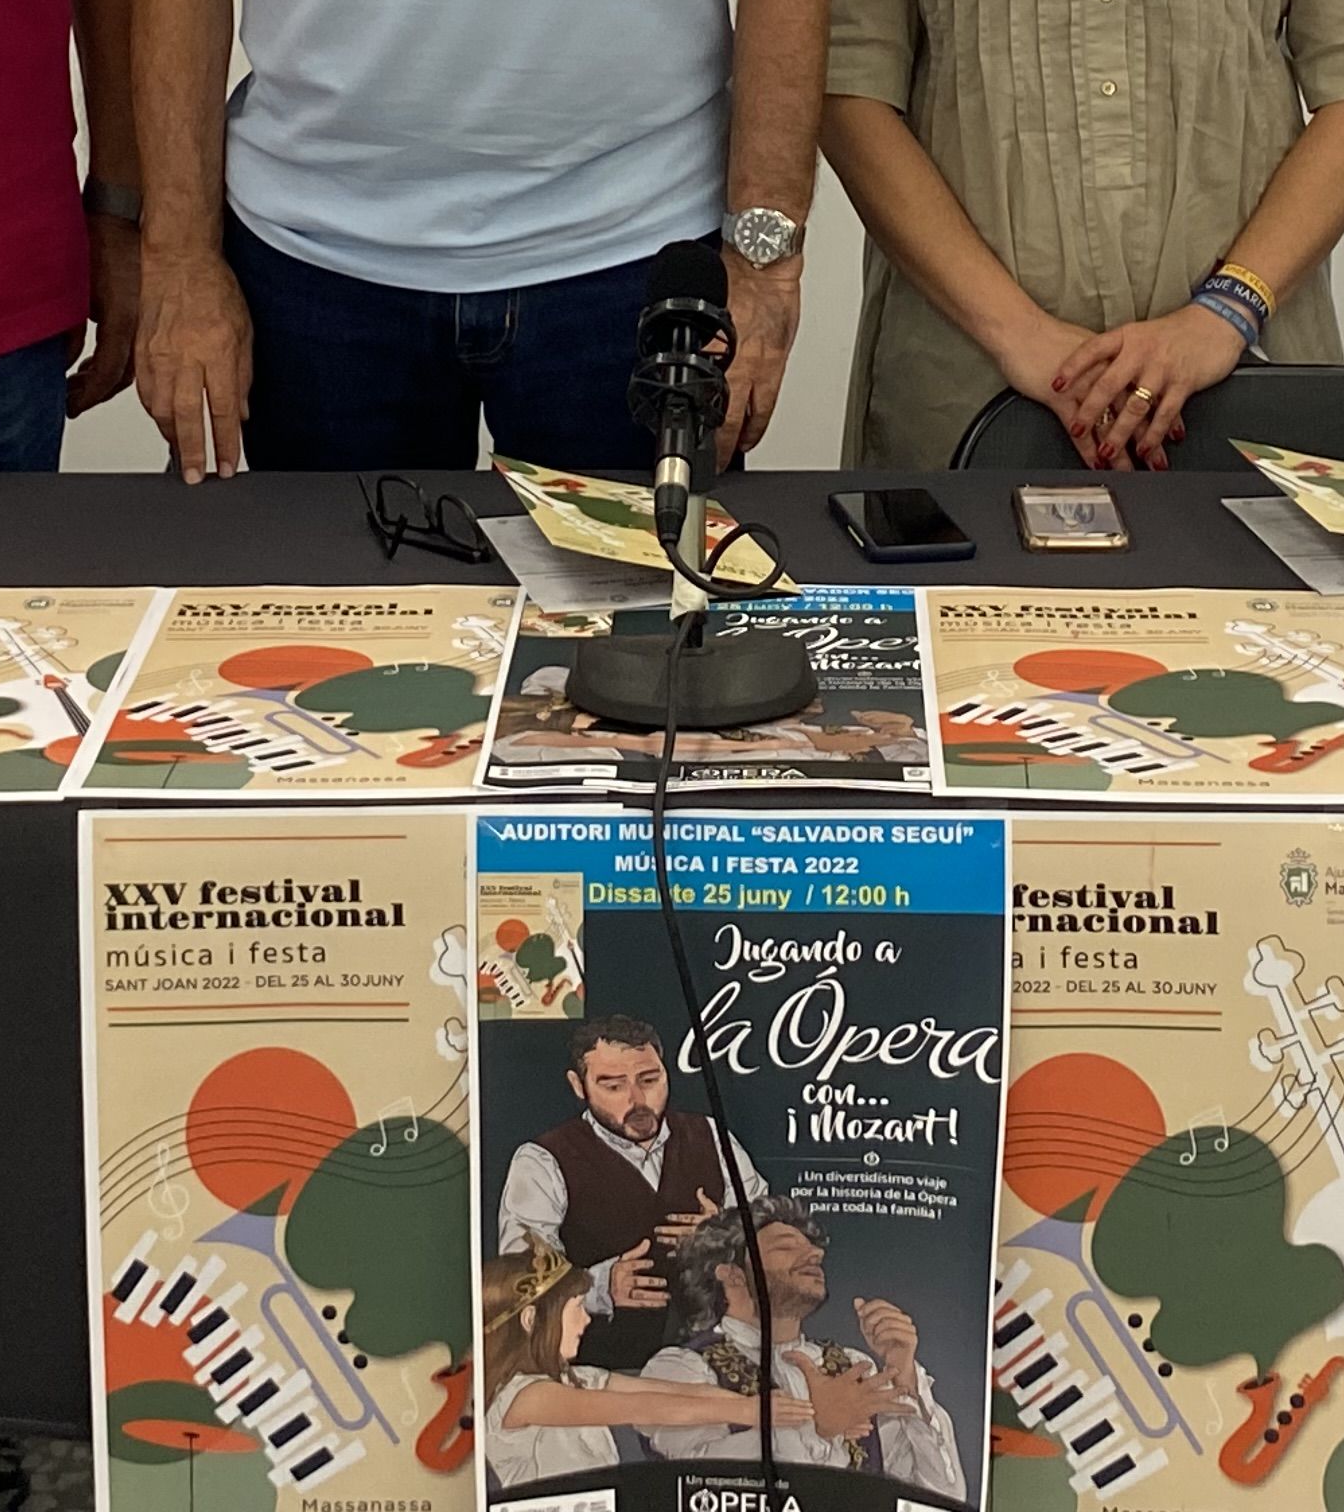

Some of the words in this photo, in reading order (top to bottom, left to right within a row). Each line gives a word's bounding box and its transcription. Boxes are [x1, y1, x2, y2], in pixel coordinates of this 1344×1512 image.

[503, 823, 610, 841] AUDITORI
[619, 824, 746, 842] MUICIPAL
[614, 850, 705, 872] MÚICA
[712, 856, 718, 872] I
[726, 857, 799, 874] FESTA
[805, 857, 860, 874] 2022
[104, 882, 187, 907] XXV
[199, 878, 362, 905] festival
[588, 882, 696, 904] Dissate
[703, 883, 732, 904] 25
[737, 883, 793, 910] juny
[822, 884, 887, 906] 12:00
[895, 885, 910, 906] h
[1012, 883, 1176, 911] festival
[104, 902, 406, 931] internacional
[1012, 908, 1220, 936] rnacional
[106, 943, 212, 967] música
[229, 943, 235, 964] i
[249, 941, 327, 964] festa
[714, 923, 862, 983] Jugando
[874, 940, 903, 964] a
[1040, 947, 1046, 969] i
[1061, 946, 1138, 970] festa
[105, 978, 148, 991] SANT
[152, 977, 198, 991] JOAN
[202, 976, 240, 989] 2022
[255, 975, 286, 988] DEL
[291, 975, 309, 988] 25
[313, 975, 335, 987] AL
[1013, 981, 1051, 993] 2022
[1066, 980, 1097, 993] DEL
[1102, 981, 1121, 993] 25
[1125, 981, 1146, 994] AL
[677, 981, 760, 1074] la
[768, 965, 1002, 1084] Ópera
[802, 1083, 890, 1106] con...
[826, 1171, 914, 1186] divertidísimo
[917, 1175, 947, 1190] viaje
[790, 1187, 814, 1199] por
[817, 1186, 829, 1197] la
[831, 1186, 882, 1199] historia
[884, 1187, 902, 1199] de
[904, 1189, 916, 1201] la
[810, 1202, 840, 1214] para
[842, 1201, 873, 1214] toda
[876, 1202, 888, 1215] la
[302, 1498, 433, 1512] Massanassa
